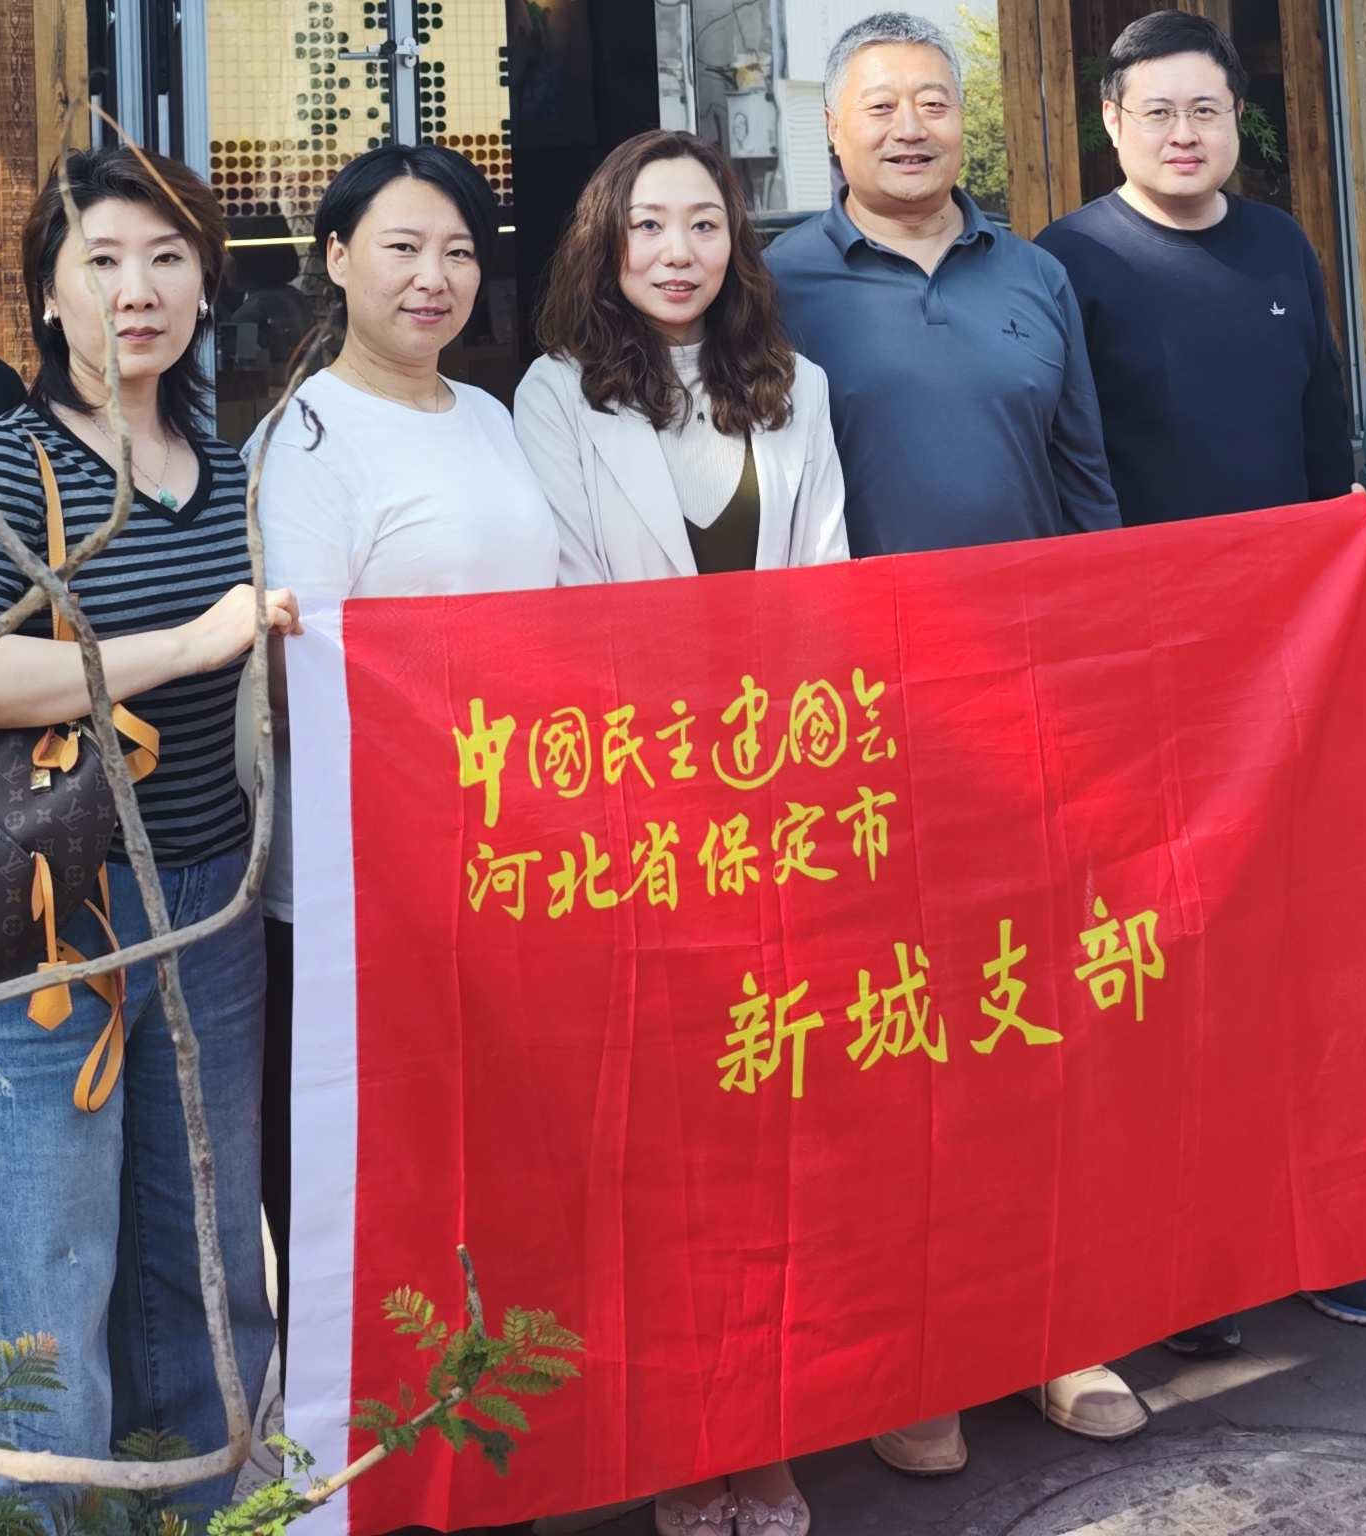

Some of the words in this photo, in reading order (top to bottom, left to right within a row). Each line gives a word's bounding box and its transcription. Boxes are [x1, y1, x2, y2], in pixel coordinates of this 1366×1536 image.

[466, 785, 897, 921] 河北省保定市
[716, 895, 1165, 1099] 新城支部
